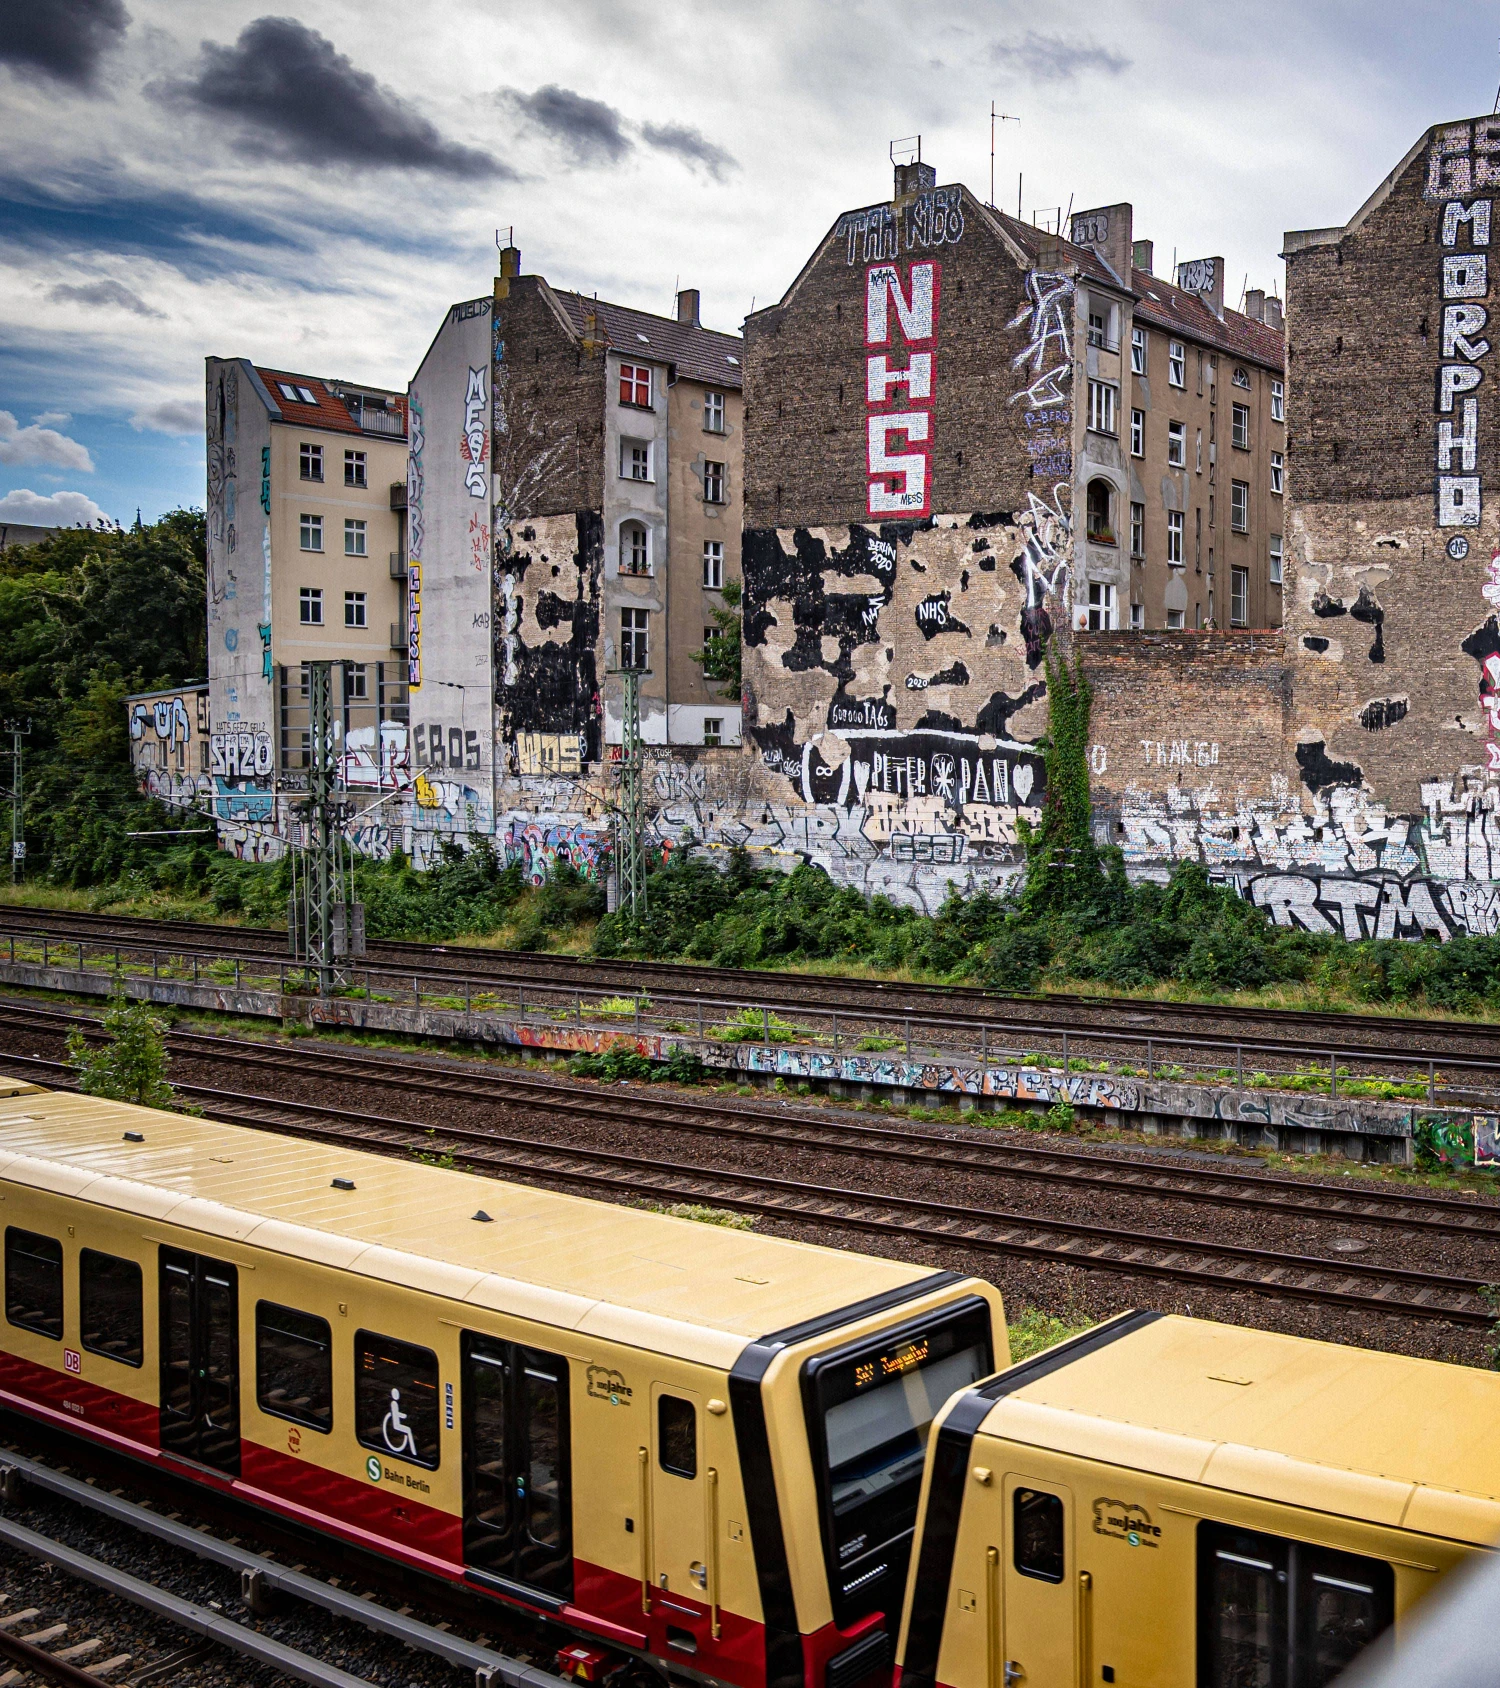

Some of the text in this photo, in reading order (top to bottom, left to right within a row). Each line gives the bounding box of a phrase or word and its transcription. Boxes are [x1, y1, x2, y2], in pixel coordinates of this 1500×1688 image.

[1435, 198, 1493, 530] MORPHO
[863, 260, 941, 520] NHS
[900, 491, 923, 505] MESS
[870, 550, 893, 571] 2020
[918, 600, 947, 625] NHS
[907, 676, 929, 688] 2020
[413, 722, 481, 771] EROS
[873, 751, 1009, 804] PETER PAN
[1243, 871, 1462, 943] RTM
[66, 1352, 79, 1371] DB
[367, 1456, 430, 1494] S Bahn Berlin
[1122, 1515, 1162, 1537] Jahre
